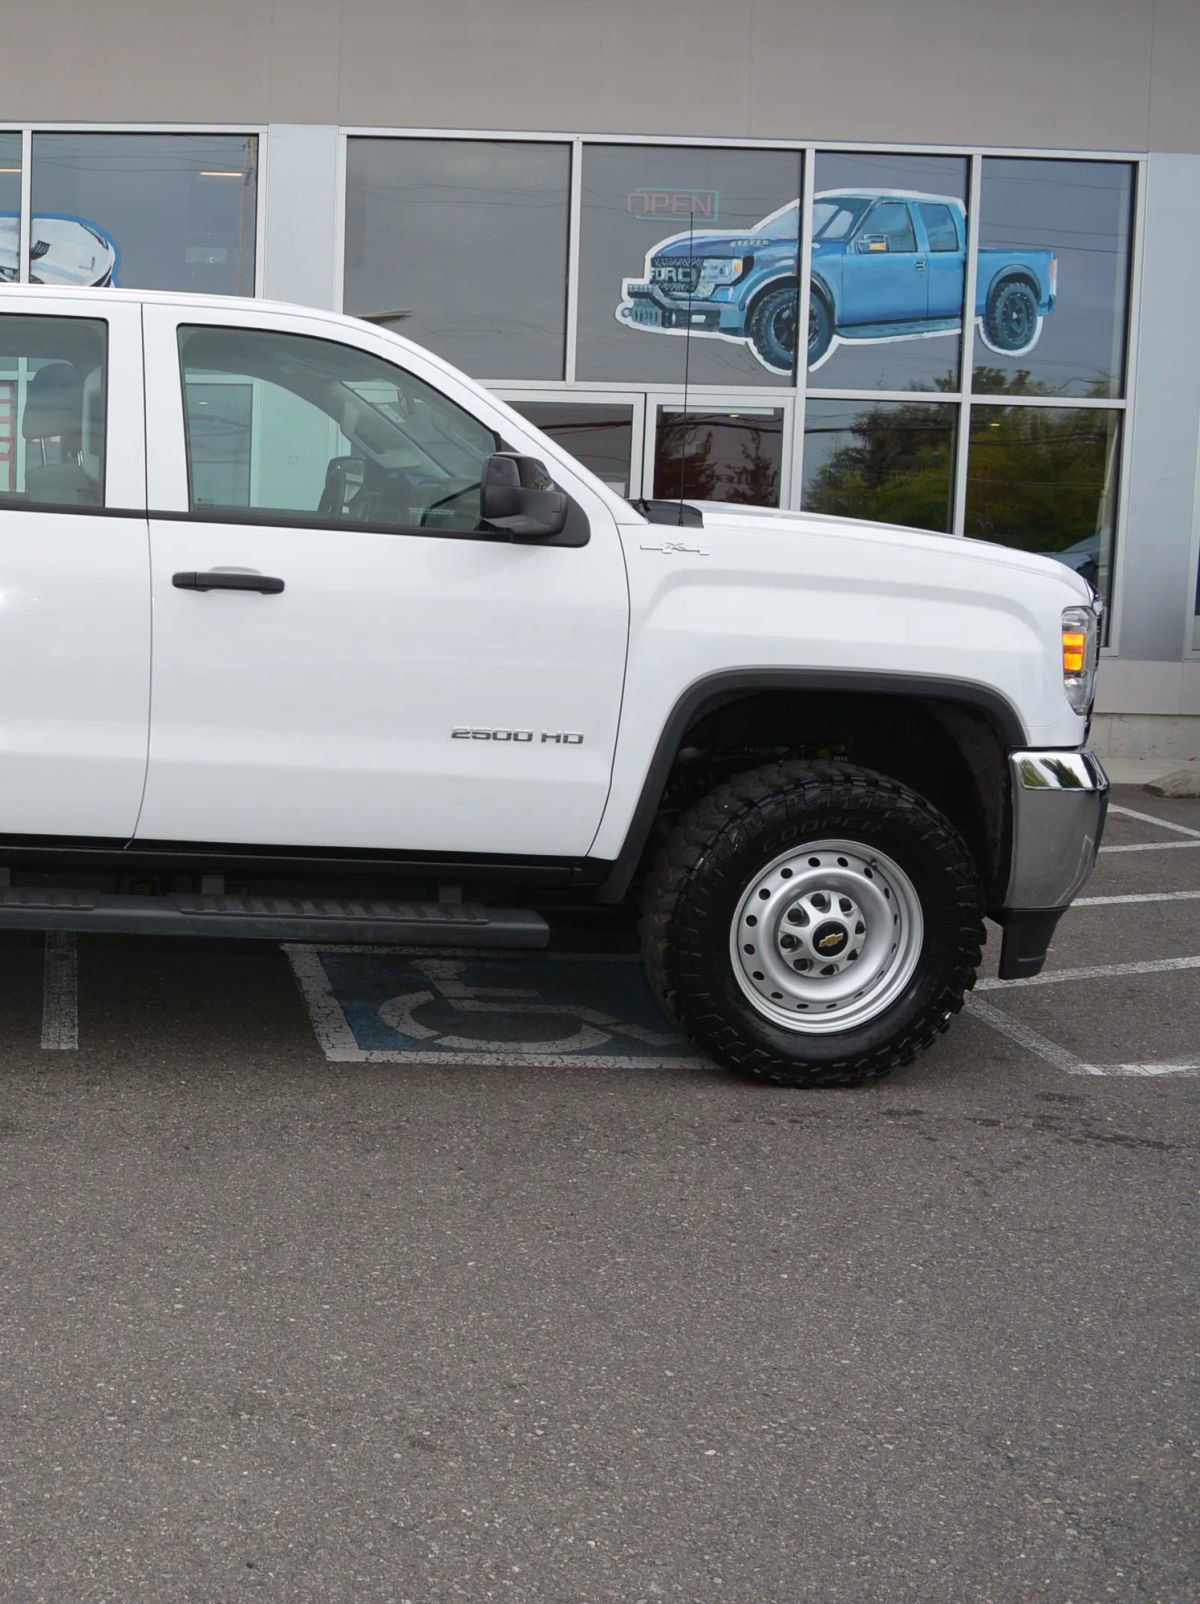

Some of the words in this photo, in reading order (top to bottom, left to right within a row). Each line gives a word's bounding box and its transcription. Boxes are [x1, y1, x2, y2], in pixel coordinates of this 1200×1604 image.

[627, 192, 712, 216] OPEN
[451, 727, 533, 742] 2500
[541, 731, 584, 745] HD
[762, 816, 882, 853] COOPER
